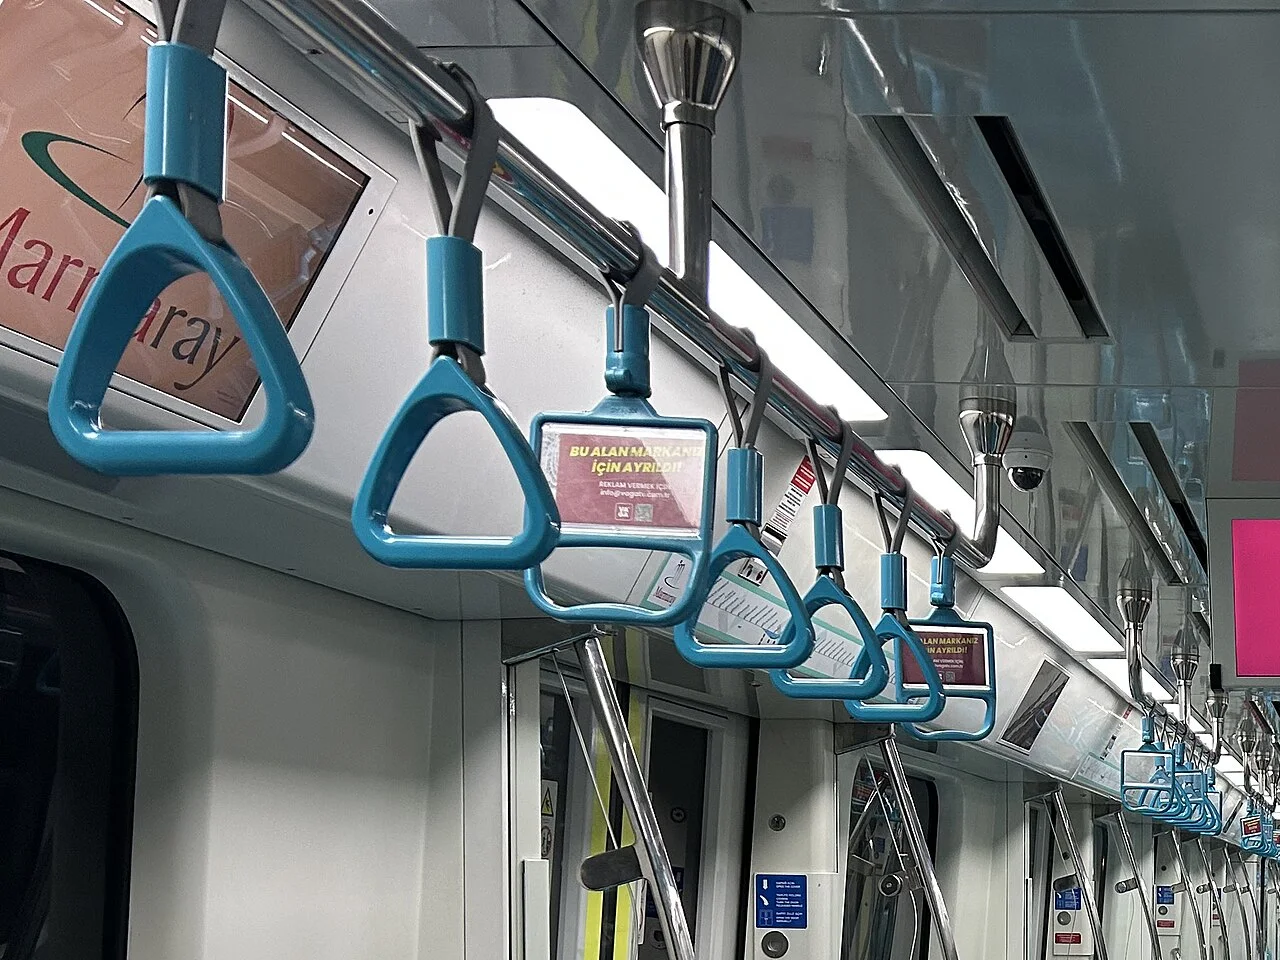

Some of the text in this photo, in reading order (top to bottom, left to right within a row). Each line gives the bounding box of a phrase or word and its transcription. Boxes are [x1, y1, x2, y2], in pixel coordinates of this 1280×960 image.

[569, 446, 589, 457] BU
[590, 446, 628, 457] ALAN
[591, 460, 621, 476] İÇİN
[939, 637, 979, 645] MARKANIZ
[937, 646, 968, 654] AYRILDI!
